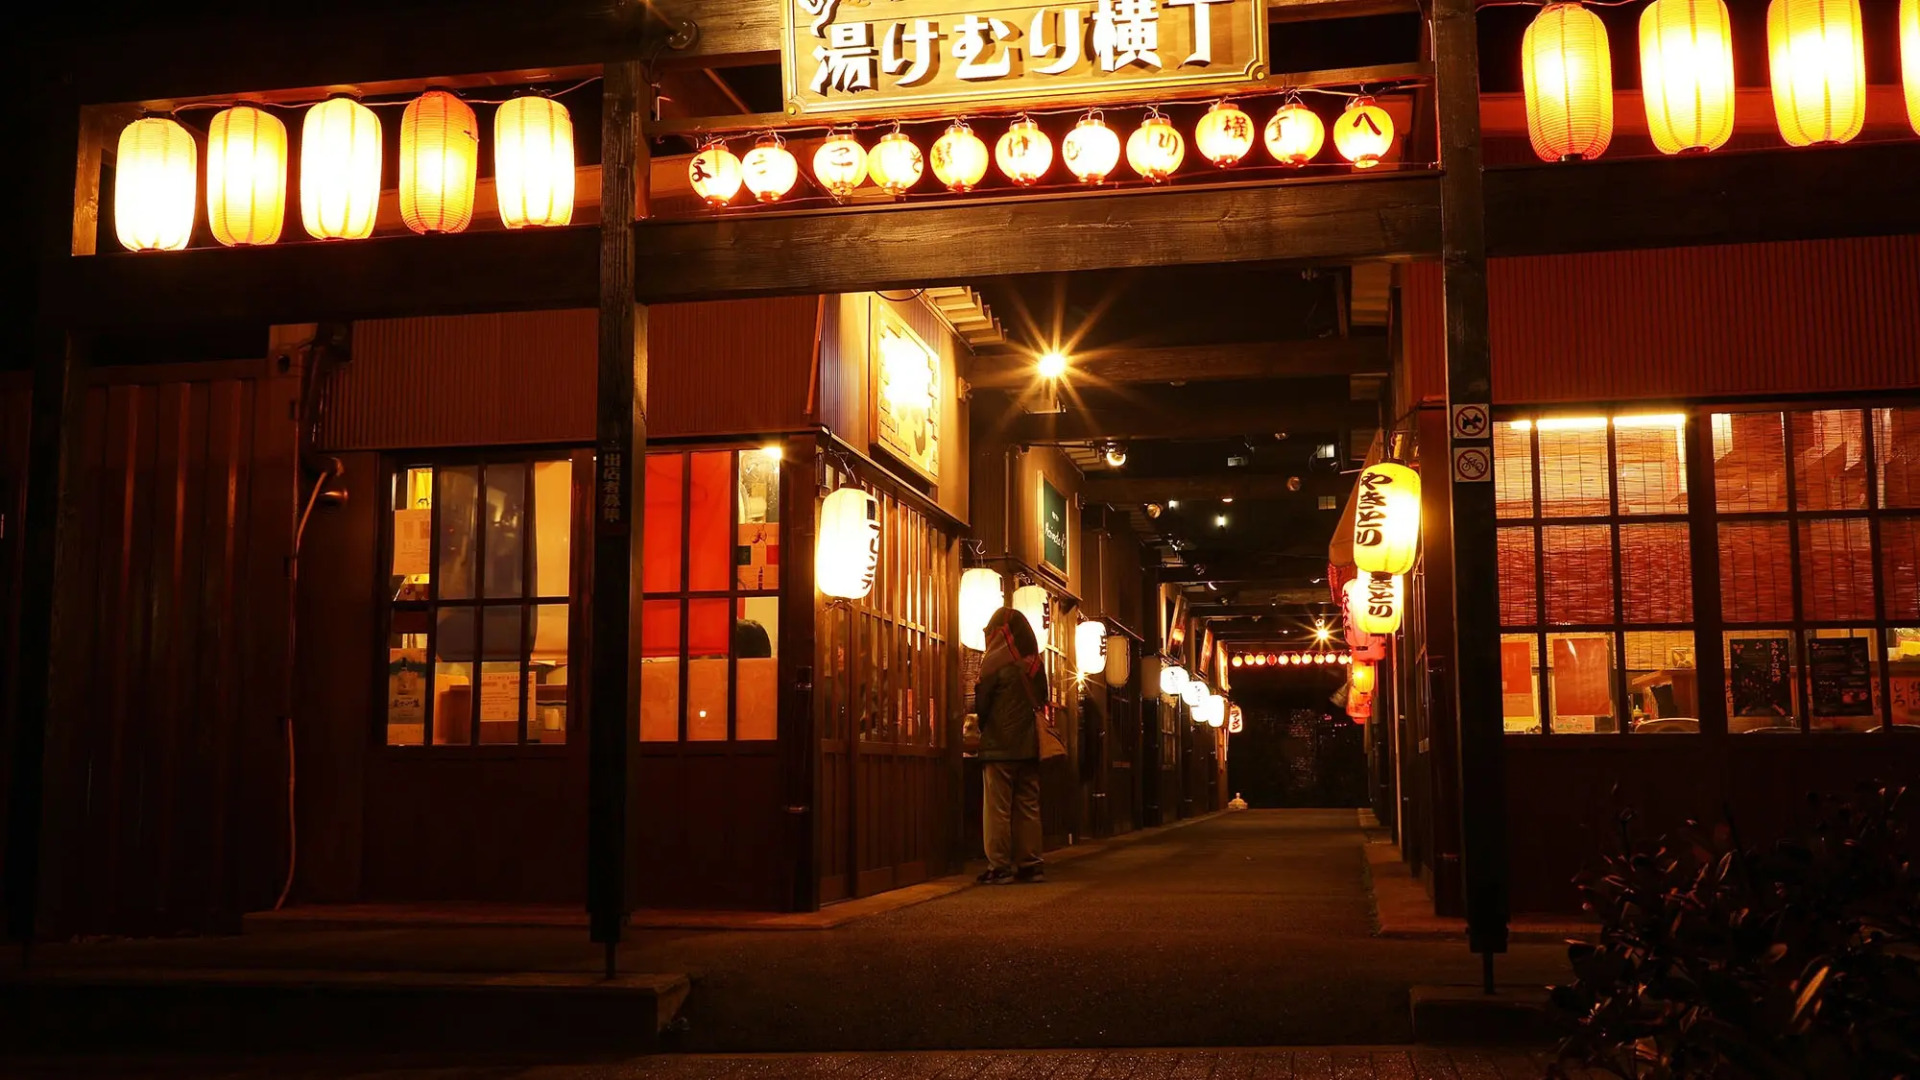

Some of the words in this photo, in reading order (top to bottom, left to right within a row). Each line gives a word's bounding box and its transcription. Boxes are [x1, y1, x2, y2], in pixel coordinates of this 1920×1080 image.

[810, 0, 1234, 94] 湯けむり横丁
[1356, 472, 1393, 547] やきとり
[1368, 577, 1394, 618] きとり
